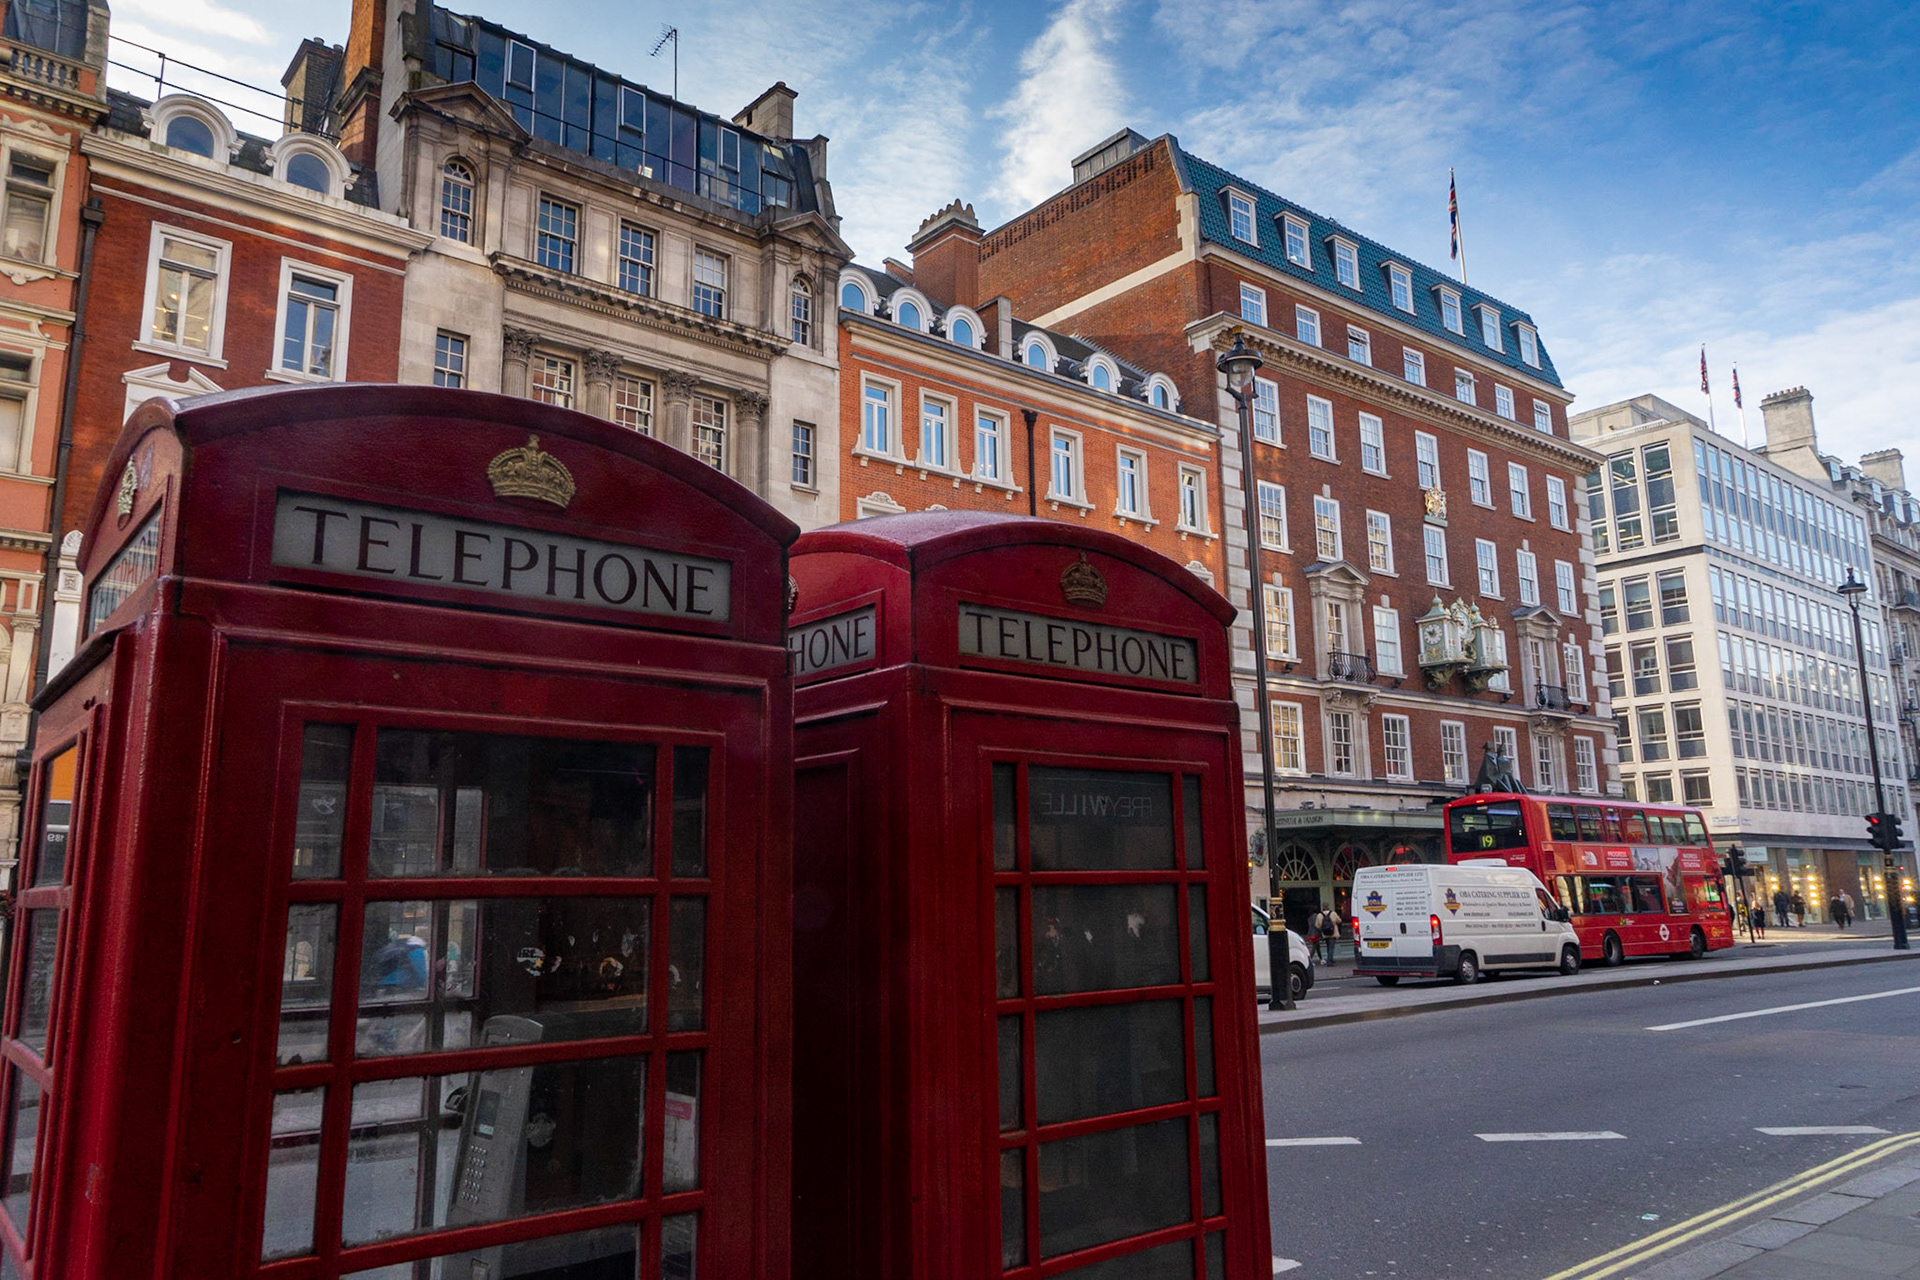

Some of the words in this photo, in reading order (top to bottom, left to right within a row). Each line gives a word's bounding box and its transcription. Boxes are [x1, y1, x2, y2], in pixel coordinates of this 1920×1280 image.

[293, 505, 714, 615] TELEPHONE
[965, 611, 1188, 680] TELEPHONE
[1481, 835, 1493, 848] 19
[1497, 891, 1520, 899] SUPPLIER
[1520, 891, 1531, 899] LTD
